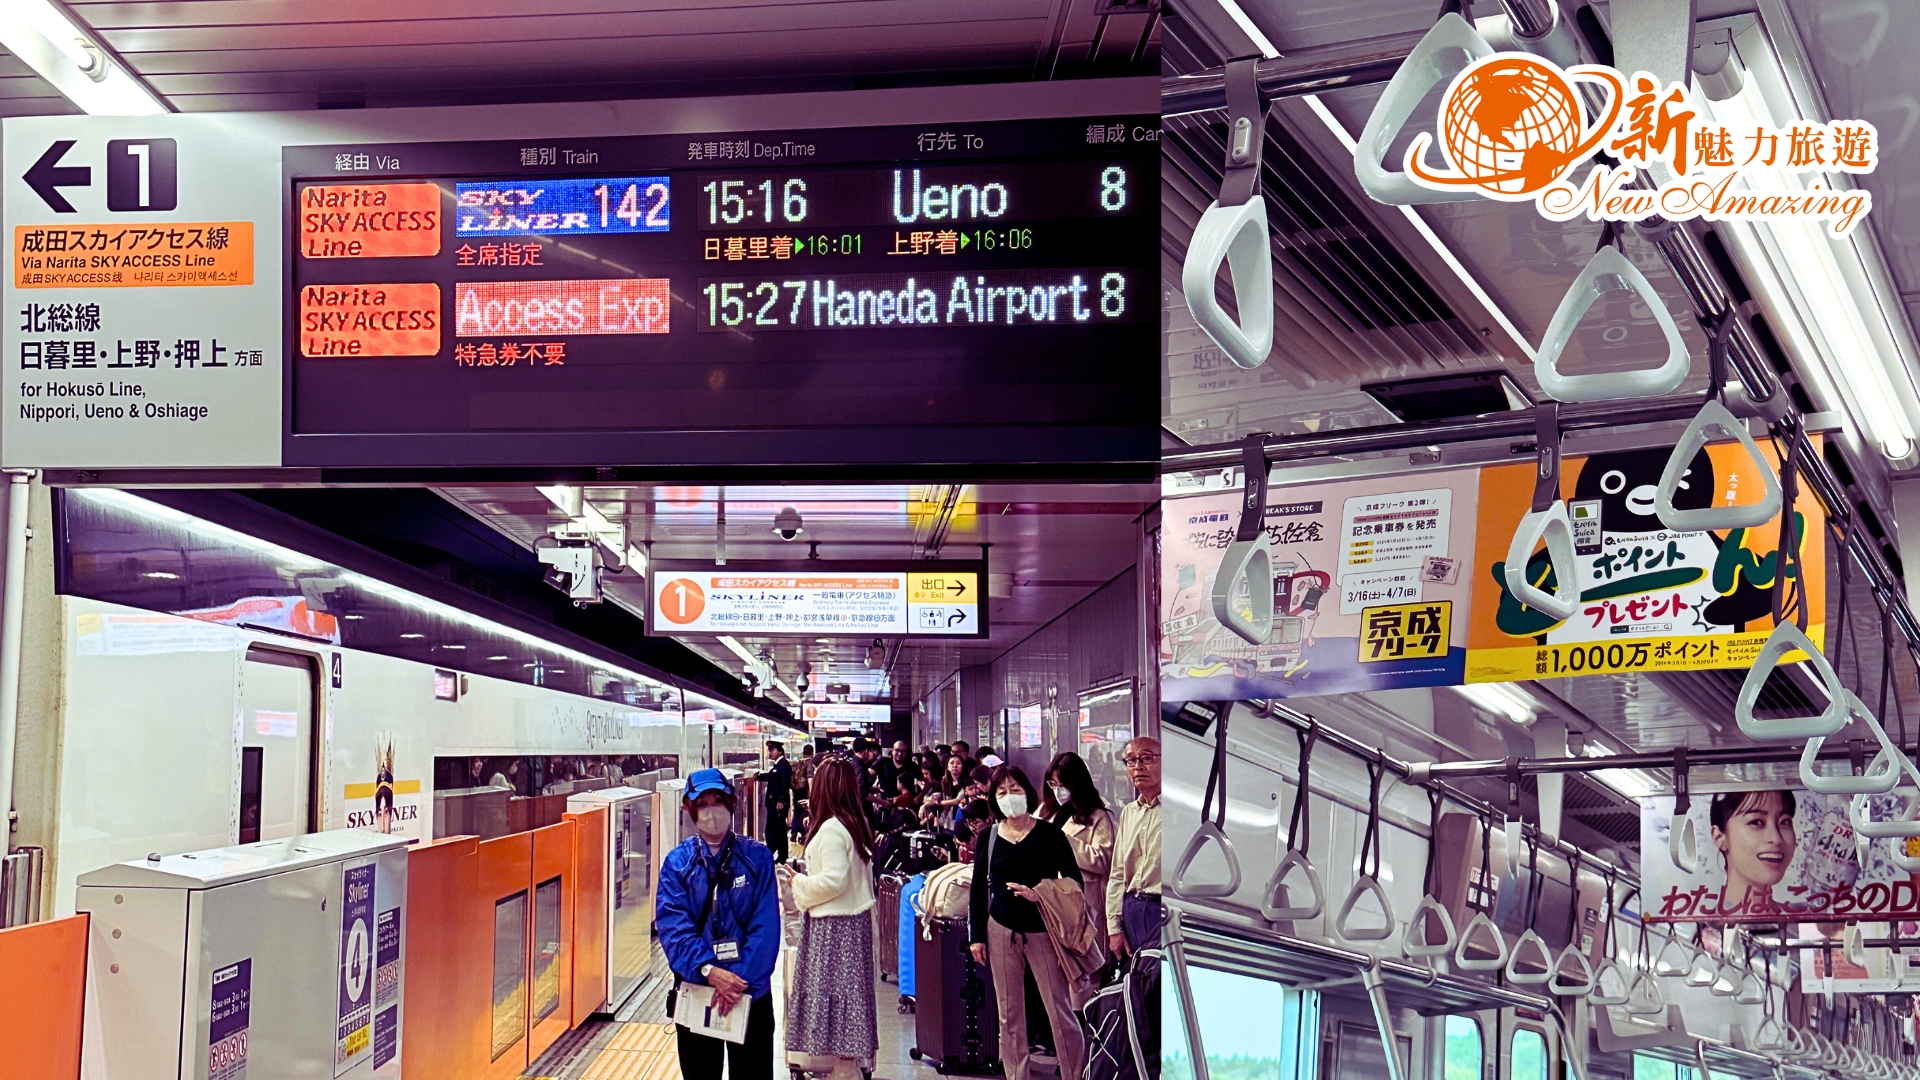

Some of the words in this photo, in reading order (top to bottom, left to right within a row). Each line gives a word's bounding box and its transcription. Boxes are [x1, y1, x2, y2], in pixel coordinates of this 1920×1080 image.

[917, 132, 957, 152] 行先
[963, 134, 984, 149] To
[1086, 124, 1125, 144] 編成
[520, 147, 556, 166] 種別
[562, 150, 598, 165] Train
[688, 141, 750, 160] 発車時刻
[754, 141, 816, 159] Dep.Time
[335, 154, 370, 172] 経由
[376, 156, 400, 170] Via
[127, 144, 150, 207] 1
[307, 188, 387, 208] Narita
[456, 188, 545, 206] SKY
[594, 182, 669, 228] 142
[703, 178, 807, 224] 15:16
[893, 169, 1007, 223] Ueno
[1100, 166, 1126, 211] 8
[22, 227, 229, 252] 成田スカイアクセス線
[308, 238, 362, 257] Line
[705, 235, 793, 261] 日暮里着
[807, 233, 862, 255] 16:01
[887, 230, 958, 256] 上野着
[974, 228, 1032, 251] 16:06
[22, 256, 41, 269] Via
[46, 256, 86, 268] Narita
[185, 254, 215, 266] Line
[455, 243, 544, 267] 全席指定
[134, 271, 163, 282] 나리타
[307, 287, 387, 307] Narita
[703, 280, 806, 327] 15:27
[813, 278, 938, 327] Haneda
[947, 275, 1089, 326] Airport
[1100, 272, 1126, 318] 8
[21, 303, 101, 333] 北総線
[457, 288, 585, 333] Access
[308, 337, 361, 356] Line
[454, 342, 566, 367] 特急券不要
[234, 350, 263, 367] 方面
[21, 382, 42, 397] for
[47, 382, 105, 397] Hokusō
[110, 381, 146, 399] Line,
[20, 404, 80, 422] Nippori,
[85, 403, 125, 419] Ueno
[129, 403, 140, 418] &
[145, 402, 208, 421] Oshiage
[1265, 506, 1290, 515] REAK'S
[1353, 519, 1436, 536] 記念乗車券を発売
[1574, 529, 1595, 537] Suica
[1593, 541, 1686, 579] ポイント
[922, 579, 944, 590] 出口
[675, 585, 687, 617] 1
[1584, 594, 1692, 628] プレゼント
[1367, 607, 1442, 637] 京成
[1367, 635, 1442, 658] フリーク
[333, 658, 340, 683] 4
[1536, 650, 1547, 674] 総額
[349, 882, 369, 903] Skyliner
[351, 933, 361, 988] 4
